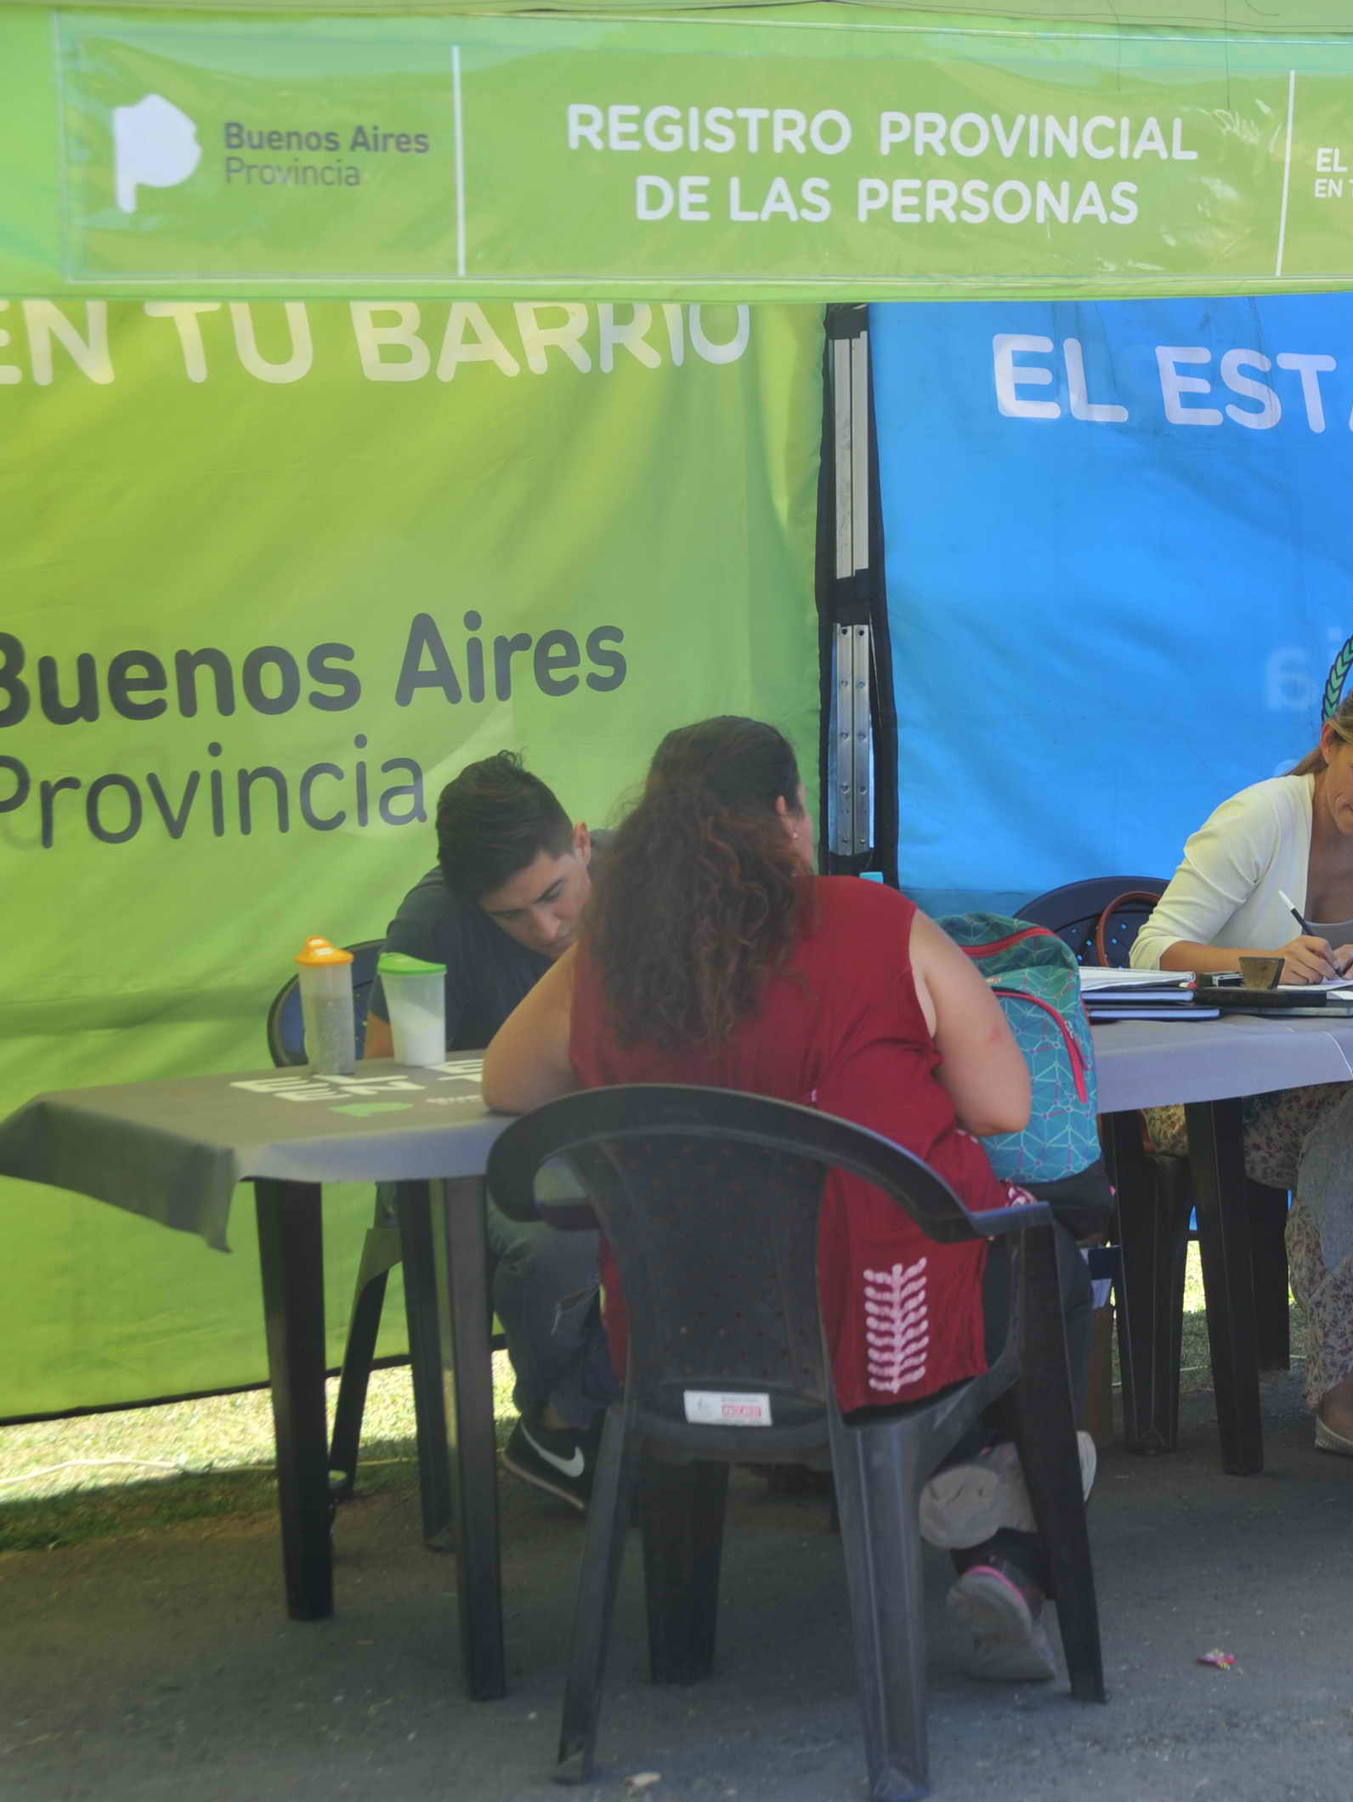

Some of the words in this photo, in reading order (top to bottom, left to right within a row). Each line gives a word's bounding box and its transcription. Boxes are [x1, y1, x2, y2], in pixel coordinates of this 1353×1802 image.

[225, 122, 340, 151] Buenos
[351, 125, 430, 154] Aires
[568, 104, 851, 155] REGISTRO
[879, 111, 1198, 161] PROVINCIAL
[225, 156, 361, 186] Provincia
[1316, 148, 1348, 173] EL
[635, 175, 711, 222] DE
[729, 177, 832, 223] LAS
[857, 179, 1139, 225] PERSONAS
[1314, 178, 1343, 198] EN
[144, 300, 313, 384] TU
[350, 300, 751, 382] BARRIO
[992, 333, 1129, 423] EL
[395, 610, 627, 708] Aires
